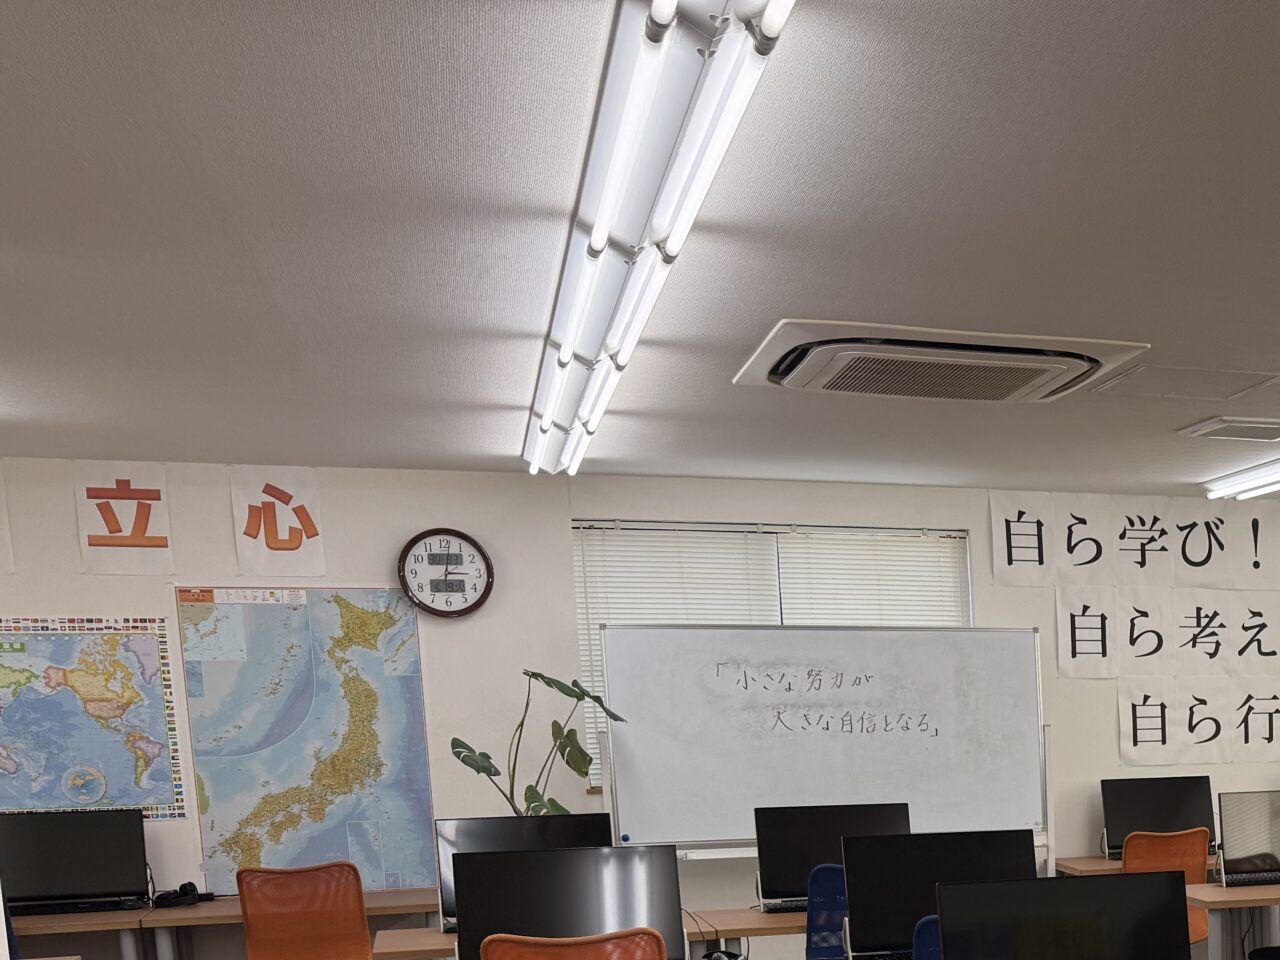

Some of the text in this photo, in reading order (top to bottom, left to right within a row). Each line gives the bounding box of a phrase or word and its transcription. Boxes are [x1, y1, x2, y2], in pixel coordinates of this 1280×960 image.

[86, 479, 320, 551] 立 心
[439, 538, 449, 549] 12
[1004, 510, 1262, 570] 自ら学び！
[424, 541, 433, 553] 11
[413, 554, 424, 564] 10
[468, 554, 476, 564] 2
[410, 568, 417, 579] 9
[475, 568, 482, 579] 3
[417, 583, 424, 592] 8
[470, 583, 477, 593] 4
[430, 594, 436, 603] 7
[445, 597, 452, 607] 6
[461, 594, 468, 603] 5
